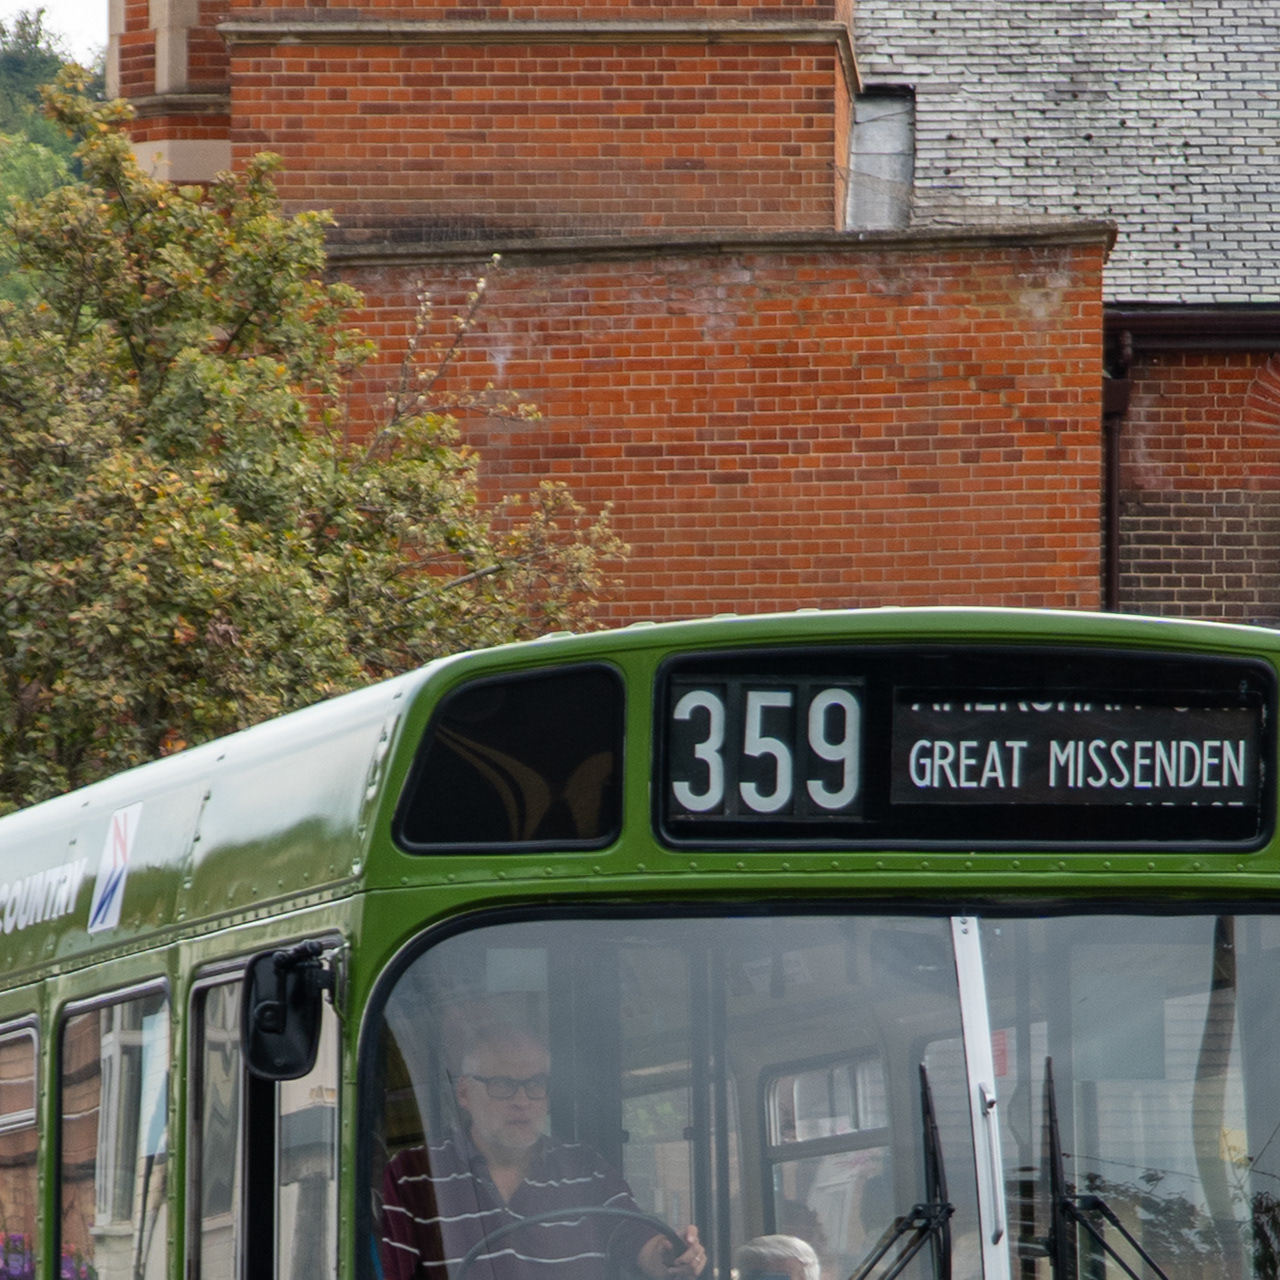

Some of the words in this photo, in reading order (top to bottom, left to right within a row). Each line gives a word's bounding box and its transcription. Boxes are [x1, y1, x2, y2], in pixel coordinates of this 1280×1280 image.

[672, 688, 861, 813] 359
[909, 740, 1028, 788] GREAT
[1049, 740, 1245, 788] MISSENDEN
